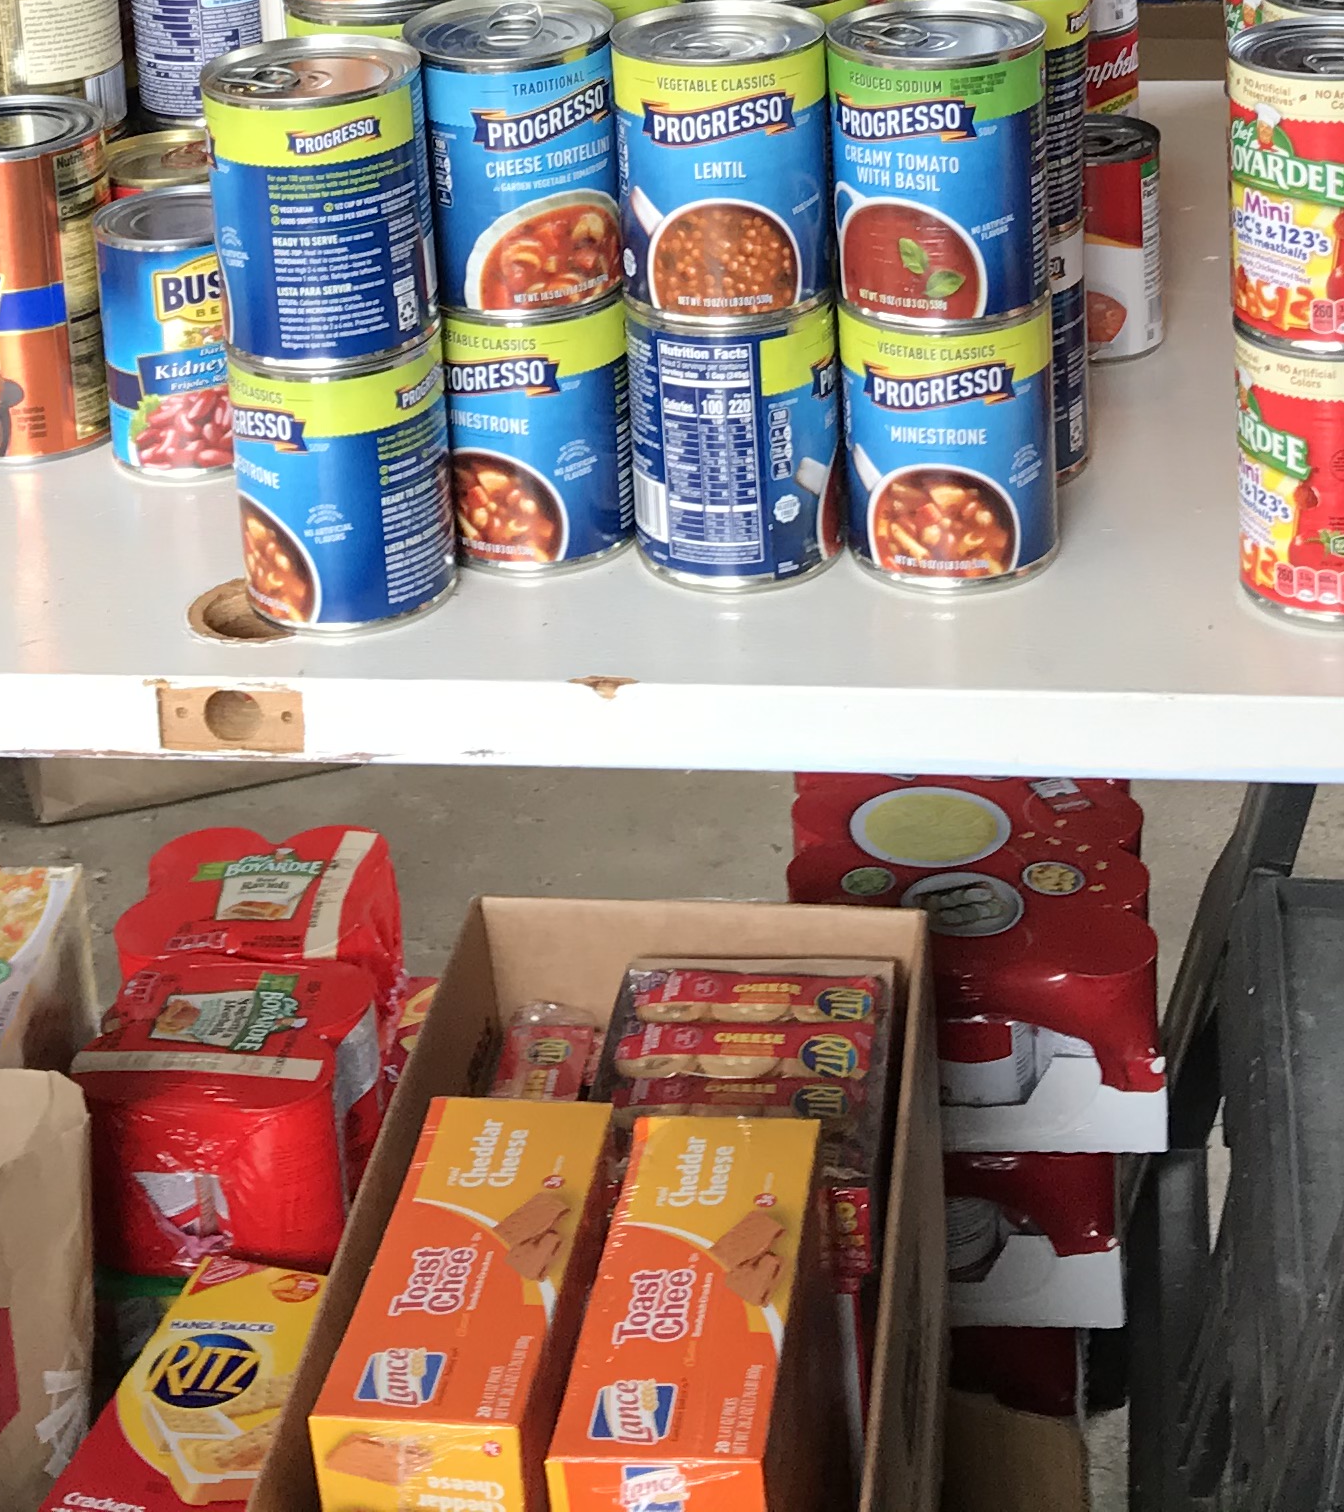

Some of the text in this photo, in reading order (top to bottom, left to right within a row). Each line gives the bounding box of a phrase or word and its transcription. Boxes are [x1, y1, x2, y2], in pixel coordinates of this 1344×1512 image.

[512, 70, 585, 97] TRADITIONAL
[657, 74, 775, 92] VEGETABLE CLASSICS
[849, 72, 942, 93] REDUCED SODIUM
[487, 86, 604, 148] PROGRESSO
[653, 98, 783, 142] PROGRESSO
[841, 105, 960, 137] PROGRESSO
[295, 120, 373, 154] PROGRESSO
[485, 137, 611, 179] CHEESE TORTELLINI
[694, 162, 746, 179] LENTIL
[845, 145, 959, 173] CREAMY TOMATO
[856, 167, 941, 191] WITH BASIL
[1244, 191, 1290, 223] Mini
[660, 345, 748, 360] Nutrition Facts
[878, 341, 995, 360] VEGETABLE CLASSICS
[155, 358, 226, 380] Kidney
[874, 370, 1003, 407] PROGRESSO
[891, 427, 987, 445] MINESTRONE
[224, 860, 324, 877] BOYARDEE
[828, 988, 868, 1021] RITZ
[714, 1032, 785, 1045] CHEESE
[811, 1034, 856, 1077] RITZ
[459, 1119, 503, 1187] Cheddar
[488, 1129, 528, 1187] Cheese
[668, 1136, 708, 1207] Cheddar
[698, 1146, 735, 1206] Cheese
[389, 1247, 448, 1317] Toast
[427, 1246, 477, 1315] Chee
[613, 1270, 667, 1345] Toast
[652, 1267, 696, 1342] Chee
[145, 1341, 261, 1396] RITZ
[384, 1348, 418, 1407] Lance
[616, 1379, 654, 1445] Lance
[63, 1492, 146, 1512] Crackers
